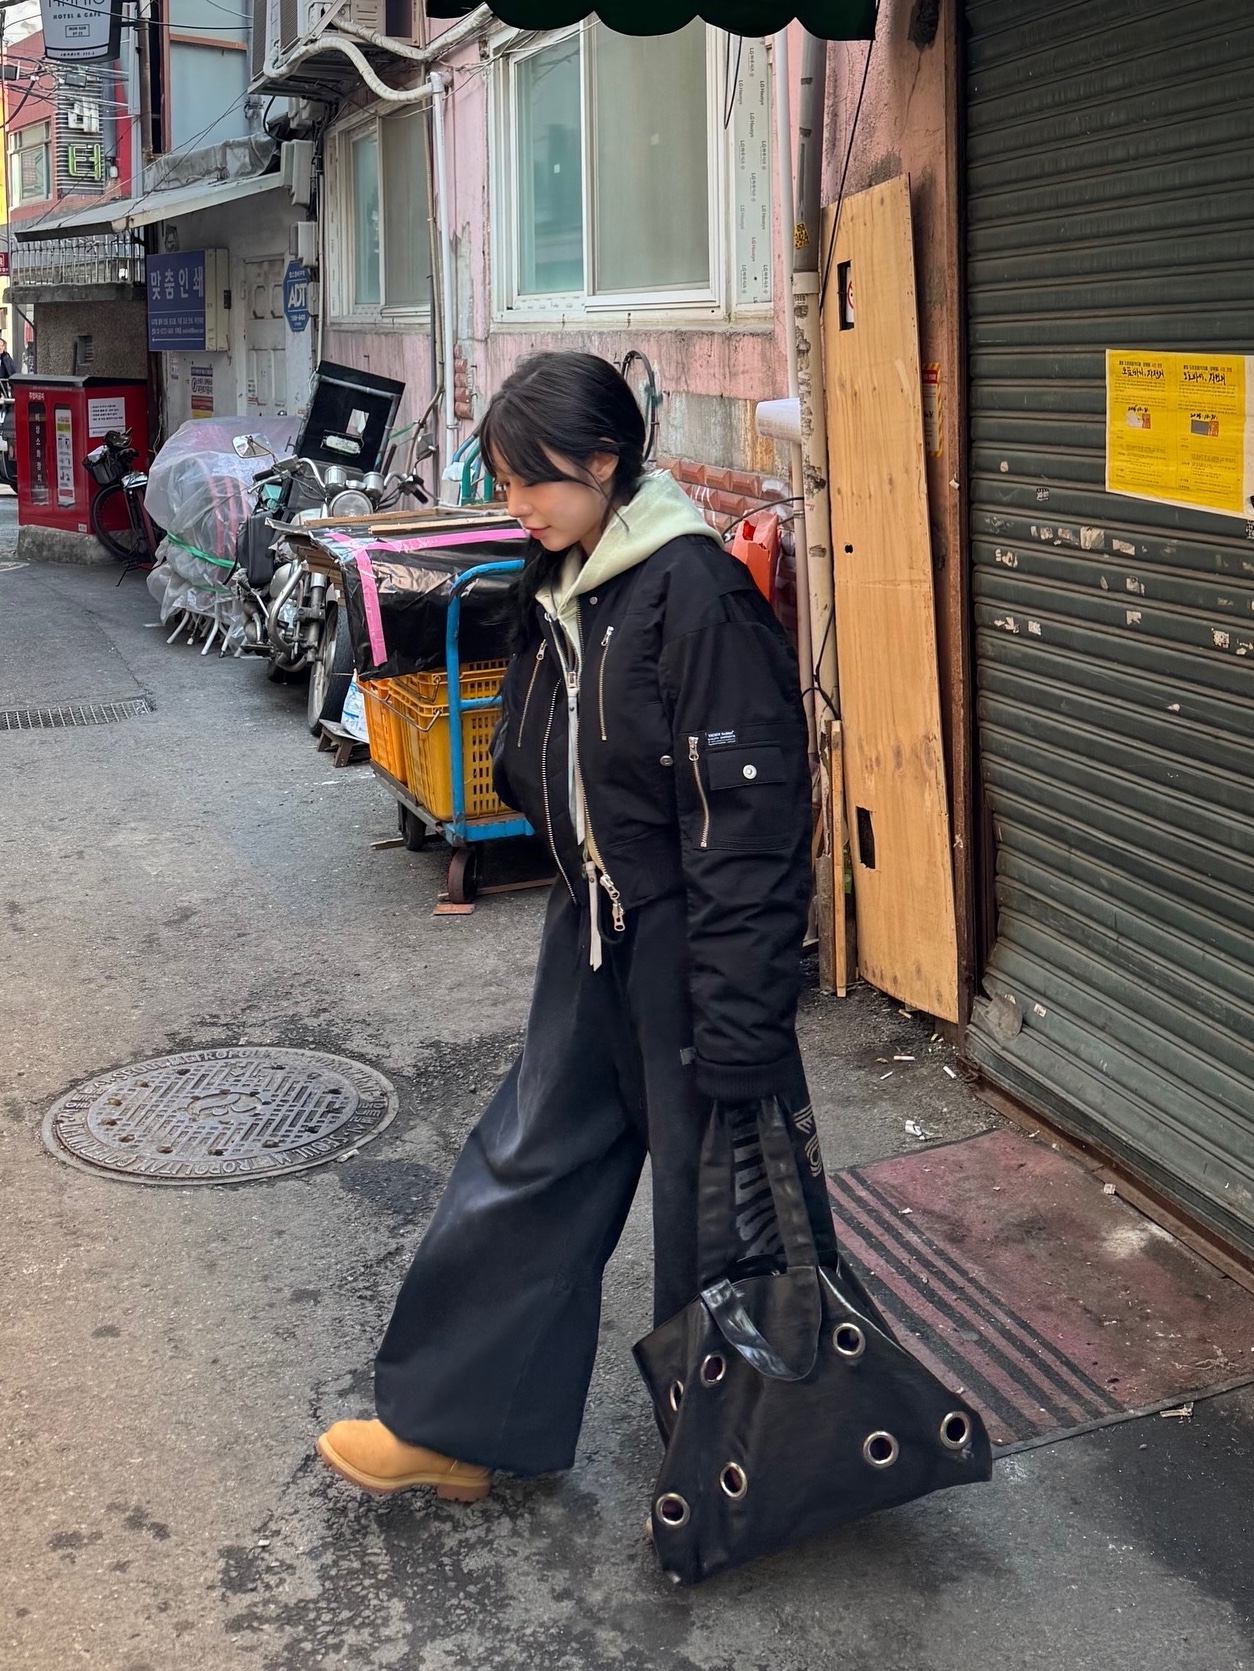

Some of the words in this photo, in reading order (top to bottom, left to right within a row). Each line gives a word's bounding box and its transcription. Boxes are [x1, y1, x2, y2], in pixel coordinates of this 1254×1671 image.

[150, 266, 203, 300] 맞춤인쇄
[288, 283, 308, 308] ADT
[116, 1059, 167, 1081] SEOUL
[59, 1121, 139, 1169] GOVERNMENT
[297, 1133, 346, 1159] SEOUL
[133, 1151, 294, 1176] METROPOLITAN
